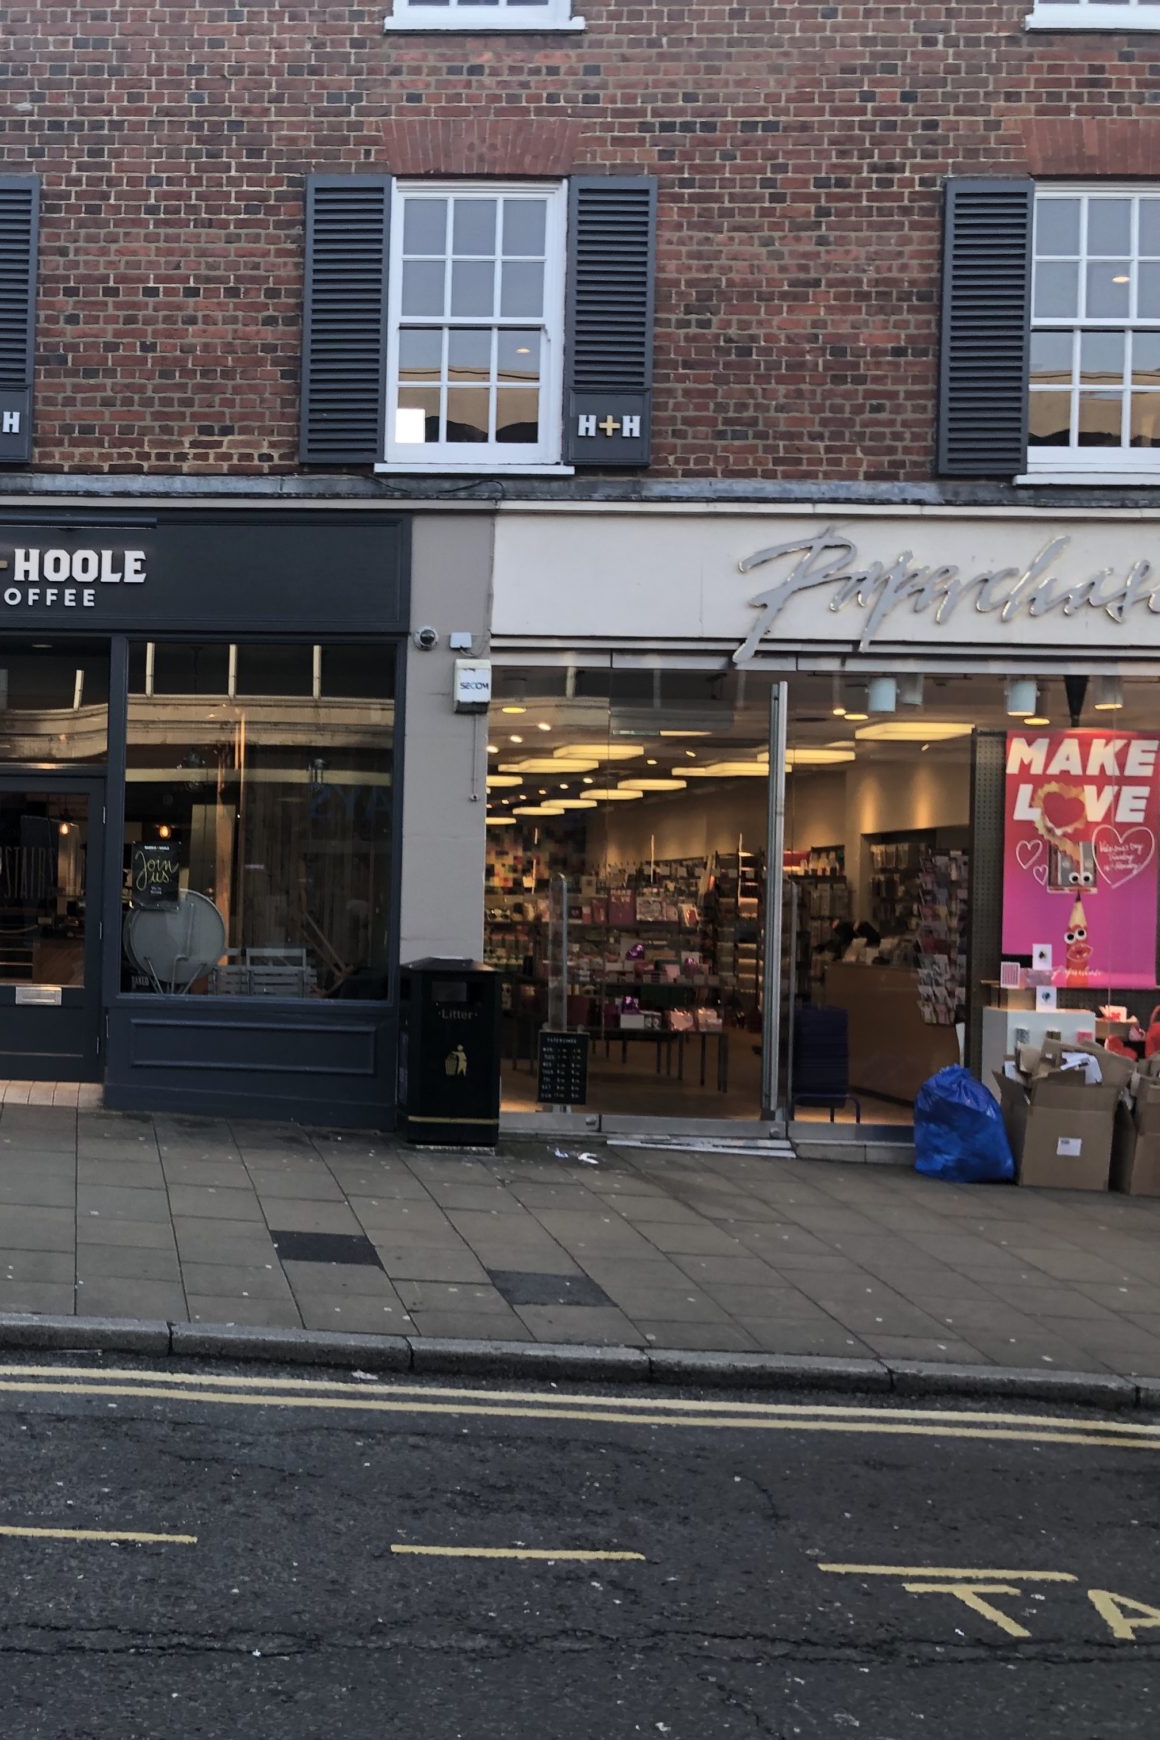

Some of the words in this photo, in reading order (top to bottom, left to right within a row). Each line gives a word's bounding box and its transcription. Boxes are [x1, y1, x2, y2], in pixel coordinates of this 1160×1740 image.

[13, 548, 147, 584] HOOLE
[460, 681, 489, 690] SECOM
[1006, 737, 1160, 777] MAKE
[134, 850, 180, 891] Join
[149, 870, 170, 884] us
[441, 1009, 474, 1021] Litter
